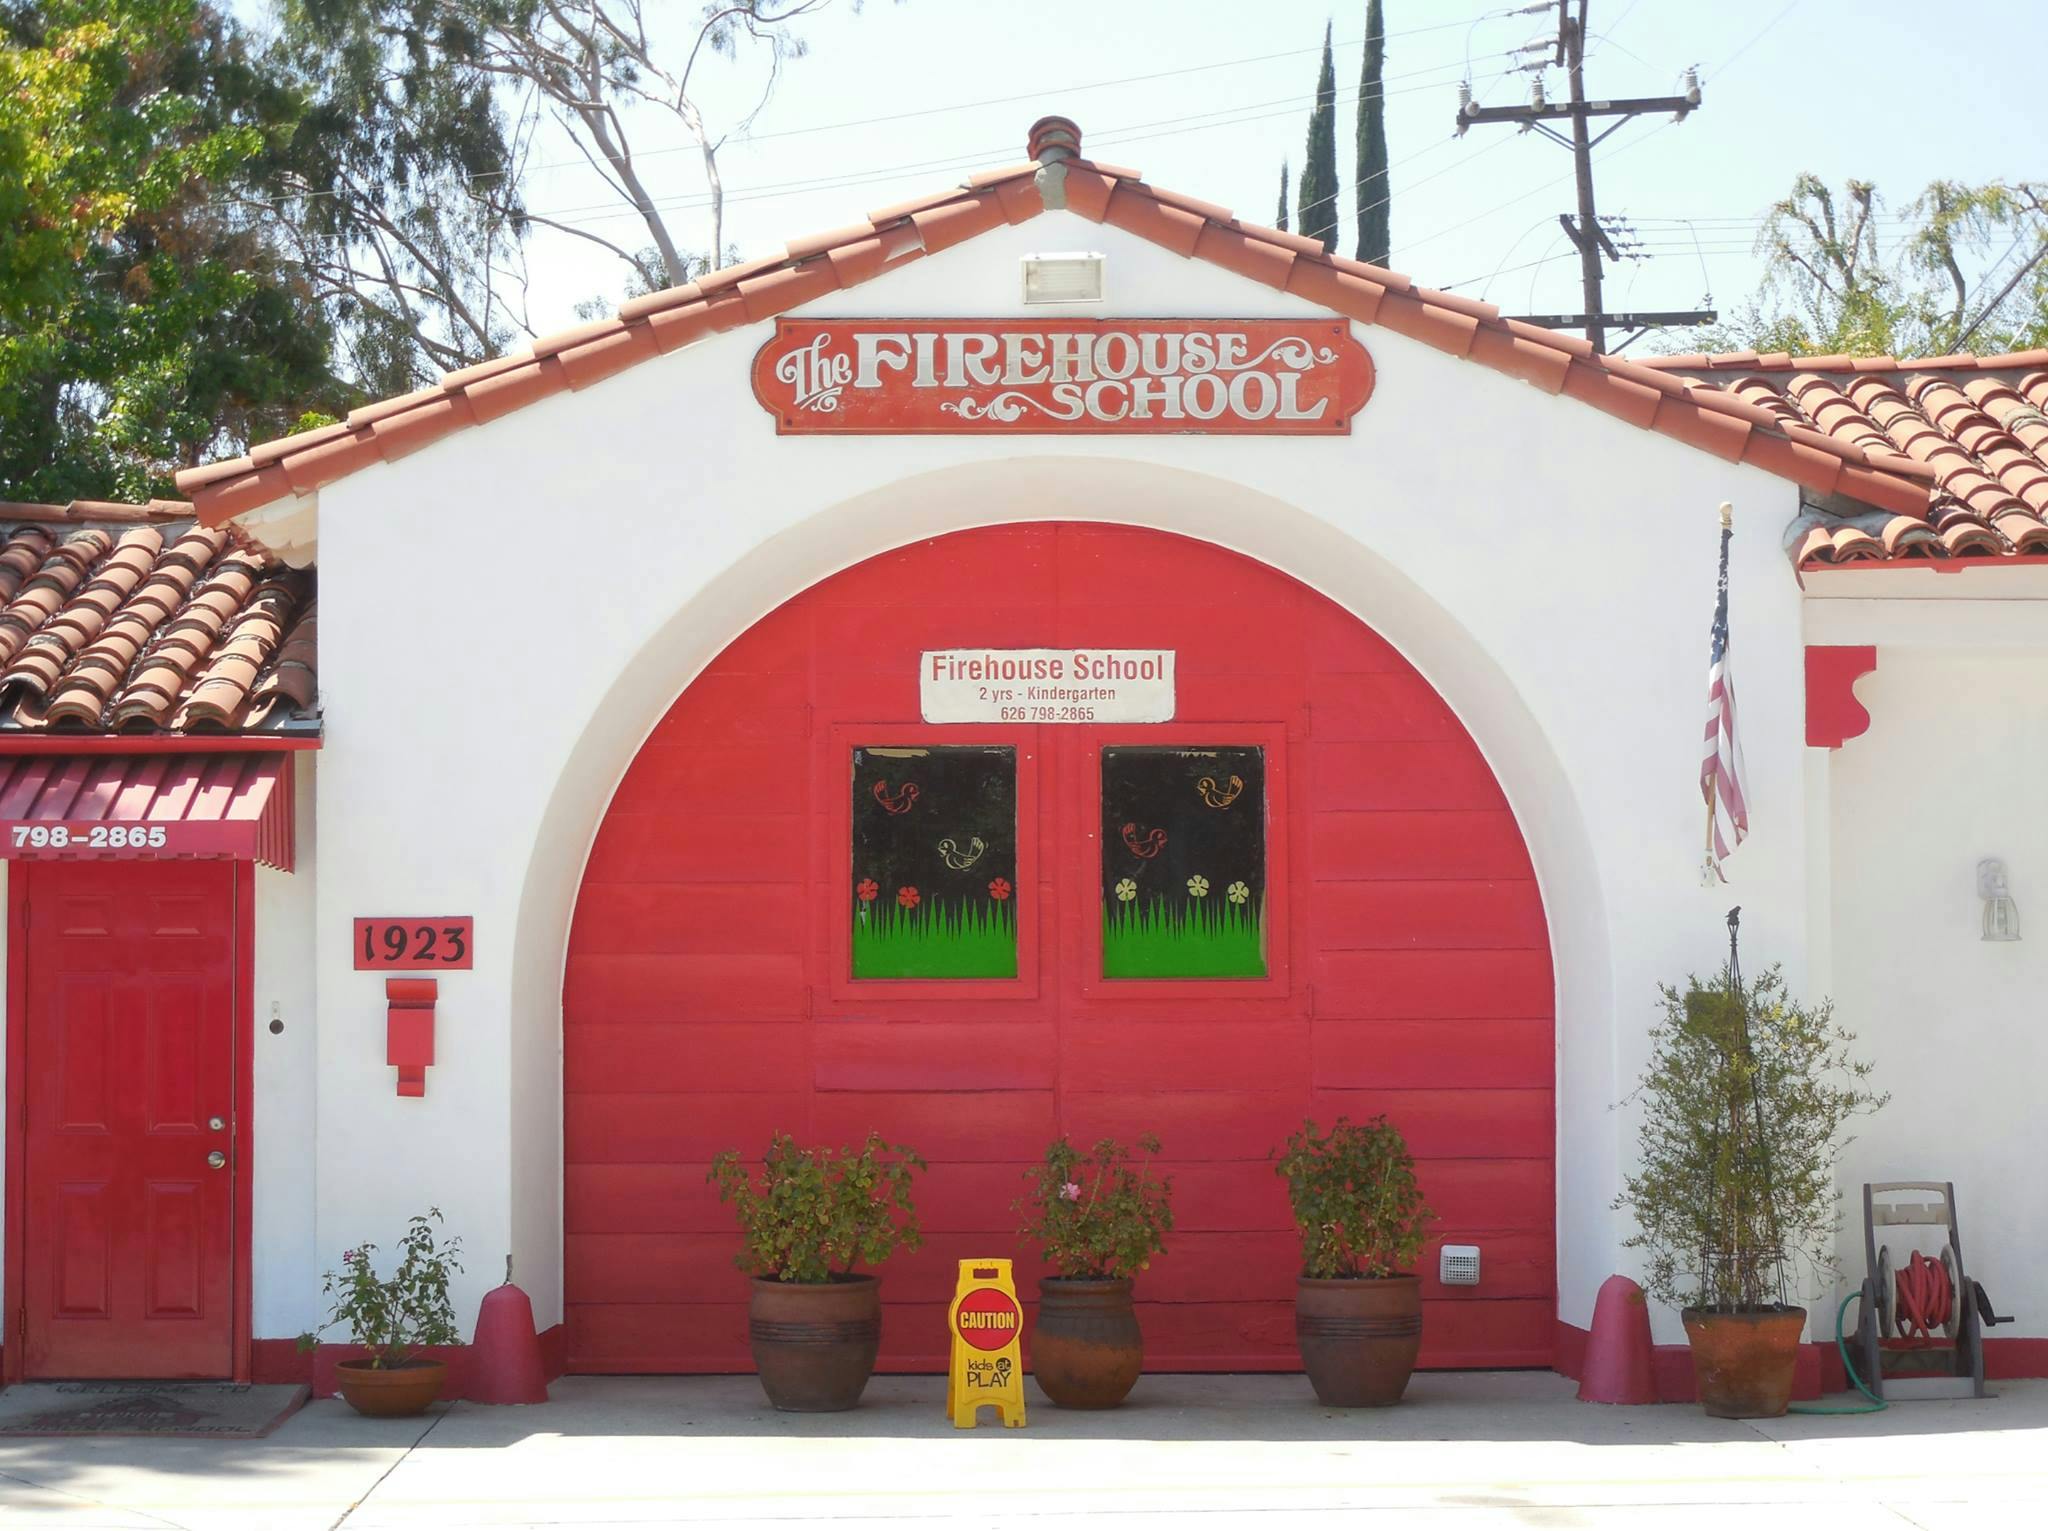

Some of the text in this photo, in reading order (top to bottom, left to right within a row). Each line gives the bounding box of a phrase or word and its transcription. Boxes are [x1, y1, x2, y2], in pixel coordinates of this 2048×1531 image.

[775, 332, 1254, 412] The FIREHOUSE
[1050, 371, 1328, 421] SCHOOL
[932, 653, 1163, 681] Firehouse School
[979, 687, 987, 700] 2
[993, 689, 1013, 702] yrs
[1027, 687, 1116, 702] Kindergarten
[1000, 707, 1095, 720] 626 798-2865
[12, 826, 167, 848] 798-2865
[365, 925, 465, 962] 1923
[960, 1311, 1015, 1329] CAUTION
[967, 1358, 1012, 1371] kids at
[967, 1371, 1012, 1388] PLAY
